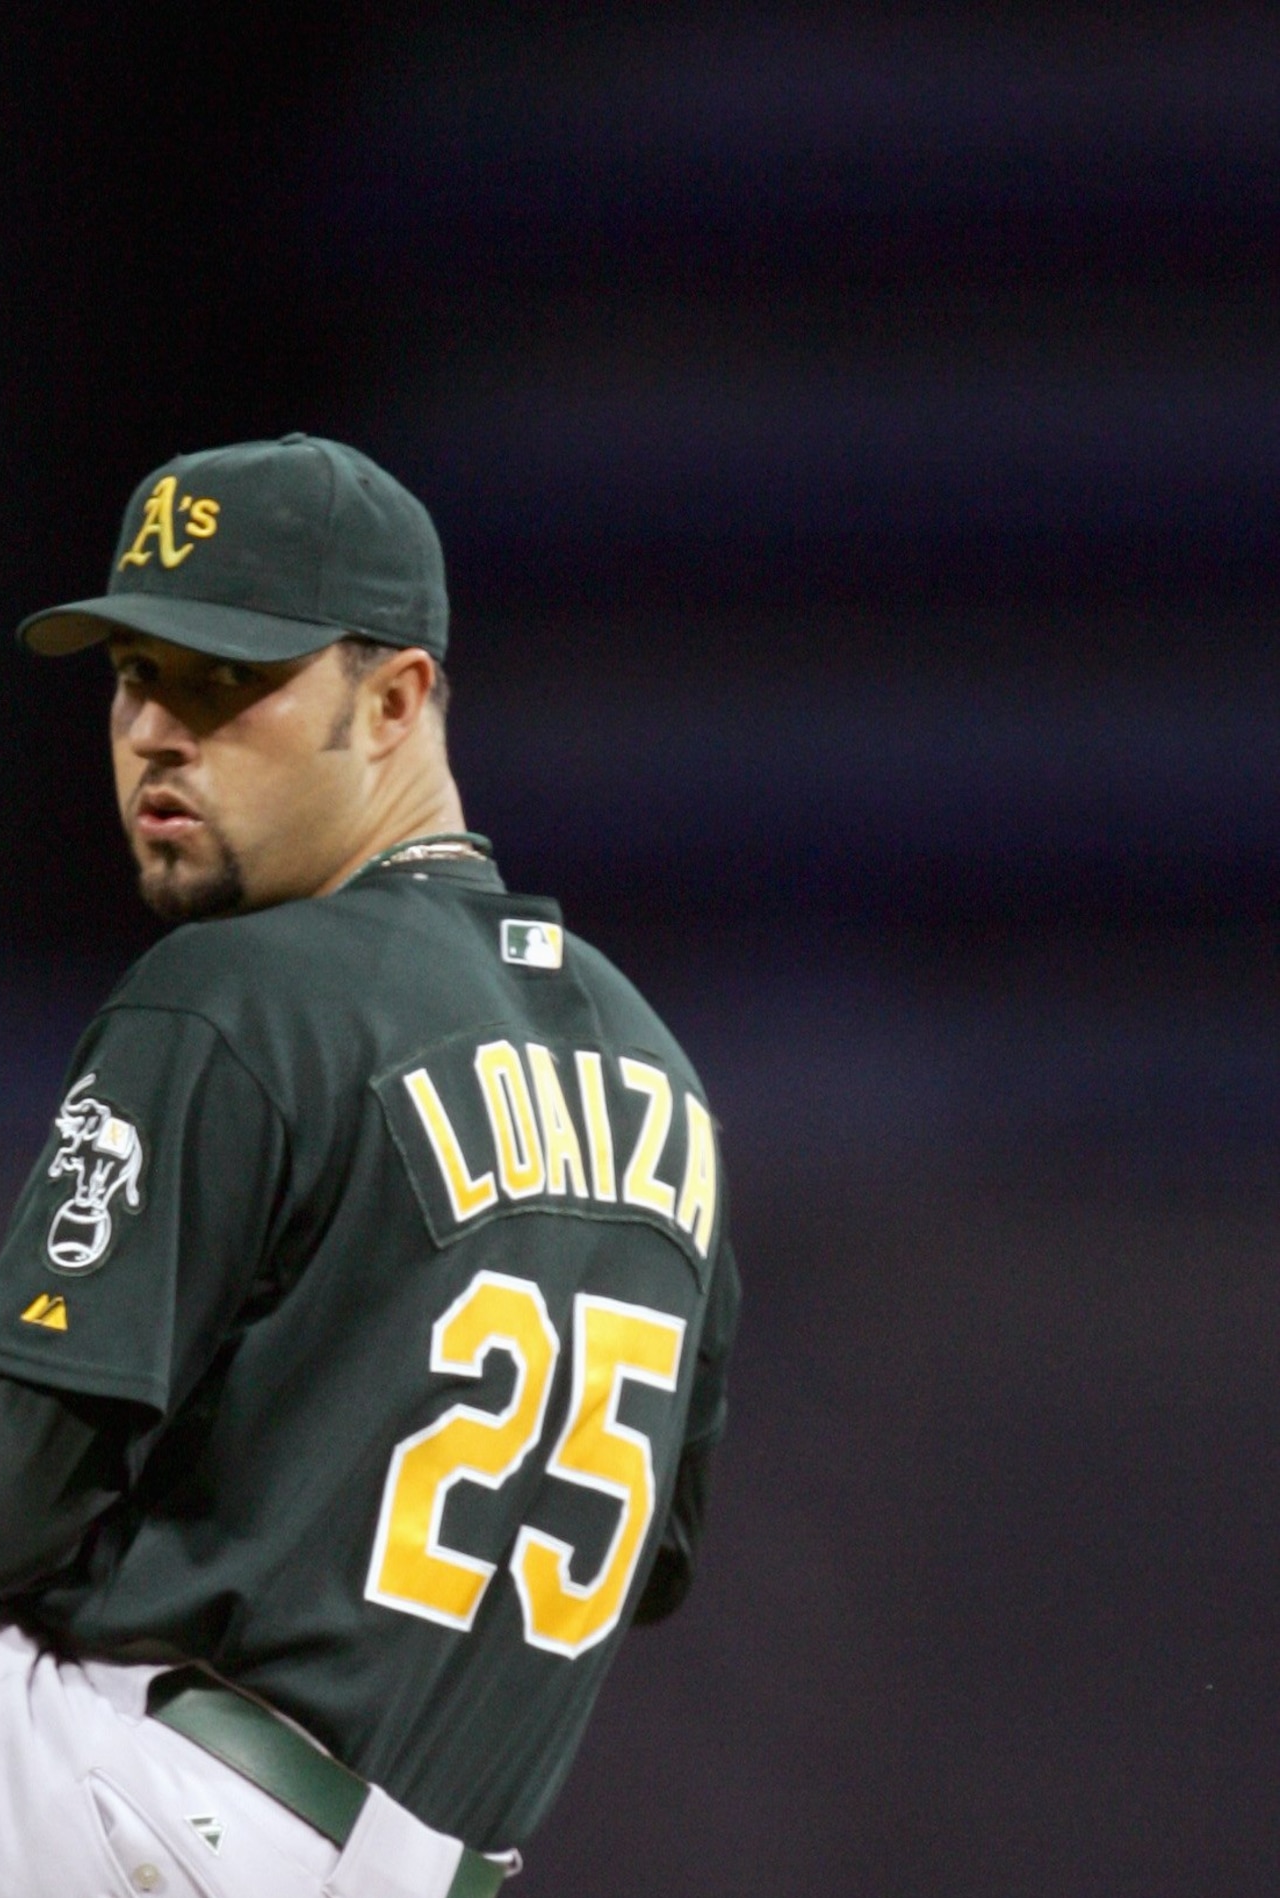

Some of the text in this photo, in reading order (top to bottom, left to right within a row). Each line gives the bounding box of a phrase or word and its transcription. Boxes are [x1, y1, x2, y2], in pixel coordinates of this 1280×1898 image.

[117, 475, 220, 572] A's
[404, 1039, 717, 1259] LOAIZA
[363, 1269, 688, 1660] 25
